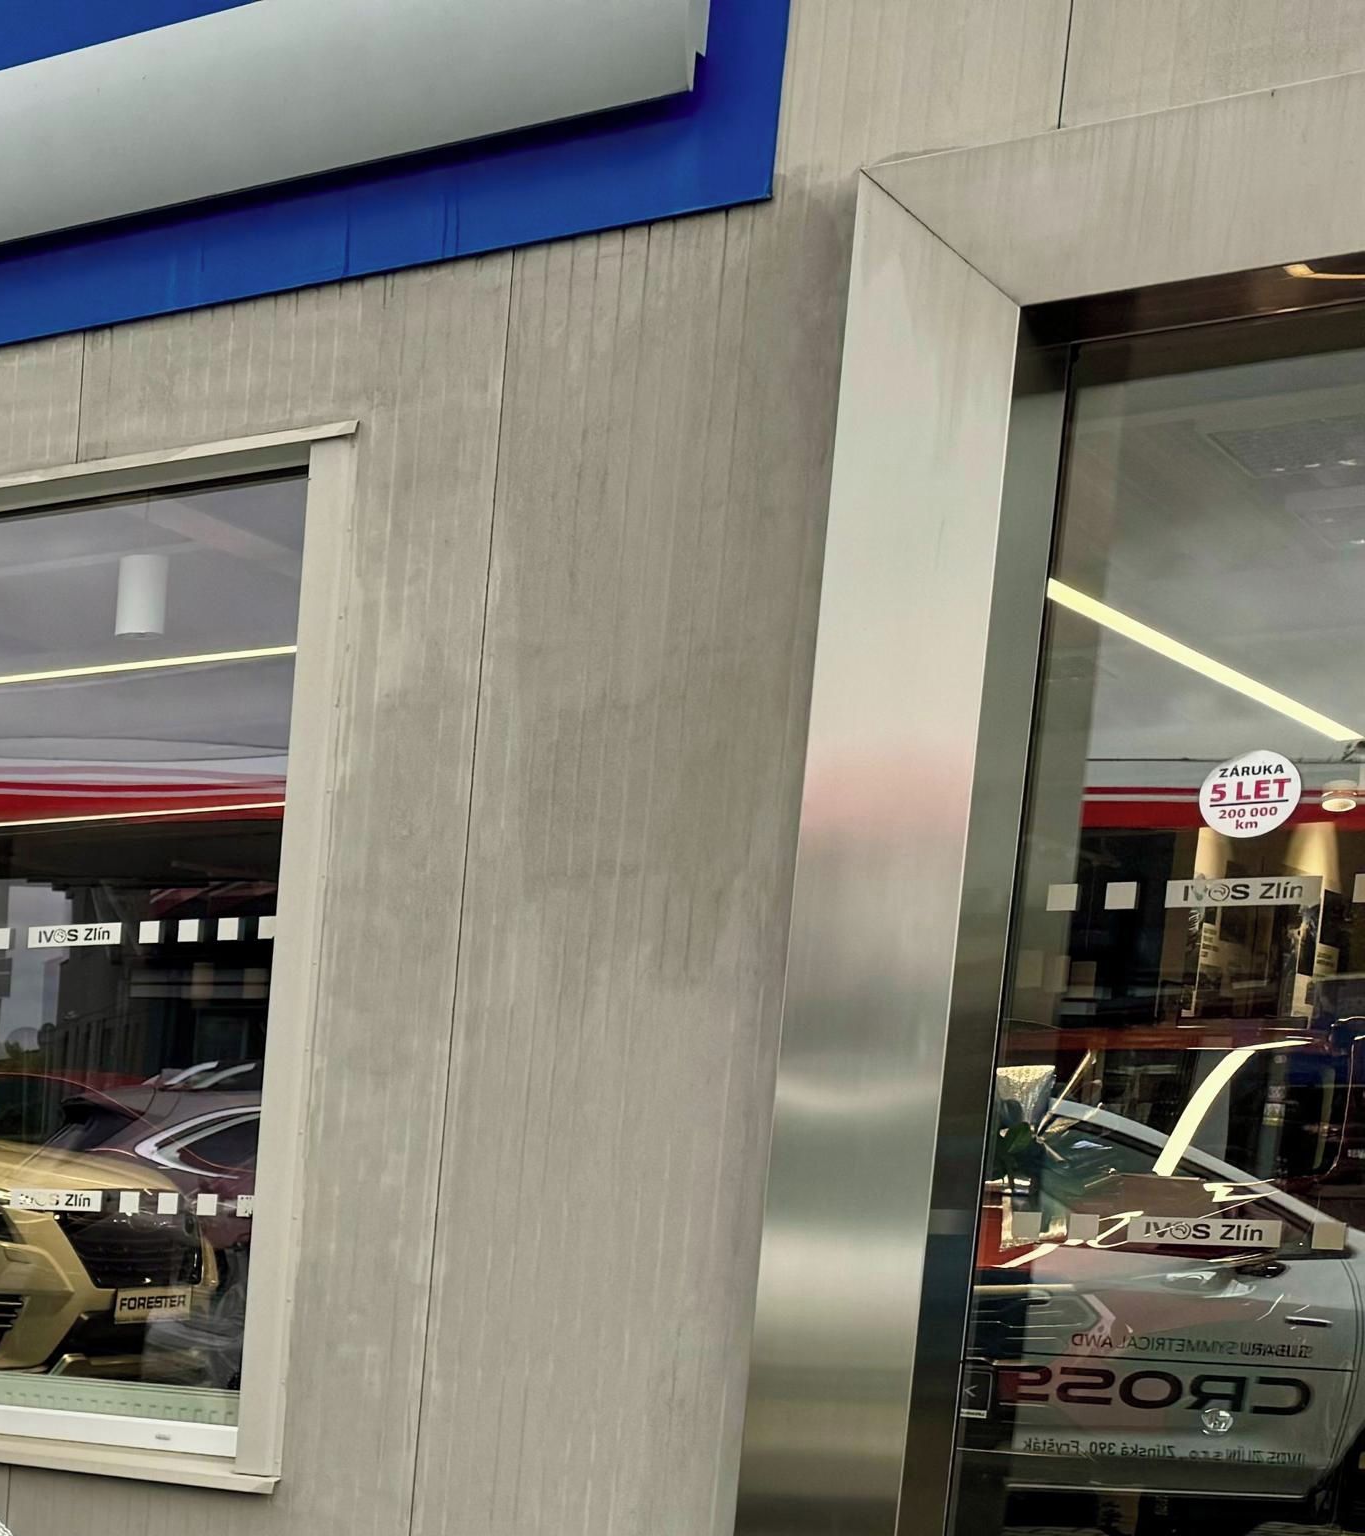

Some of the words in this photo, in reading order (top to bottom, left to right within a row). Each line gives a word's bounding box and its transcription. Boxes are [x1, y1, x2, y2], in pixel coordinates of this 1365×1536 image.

[1218, 764, 1285, 778] ZÁRUKA
[1210, 783, 1227, 802] 5
[1235, 778, 1292, 801] LET
[1218, 808, 1246, 819] 200
[1250, 806, 1278, 818] 000
[1235, 819, 1258, 830] km
[1183, 883, 1250, 901] IVOS
[1259, 881, 1303, 899] Zlín
[38, 928, 79, 943] IVOS
[84, 926, 111, 941] Zlín
[65, 1193, 91, 1207] Zlín
[1144, 1221, 1211, 1240] IVOS
[1219, 1224, 1263, 1241] Zlín
[119, 1294, 186, 1311] FORESTER
